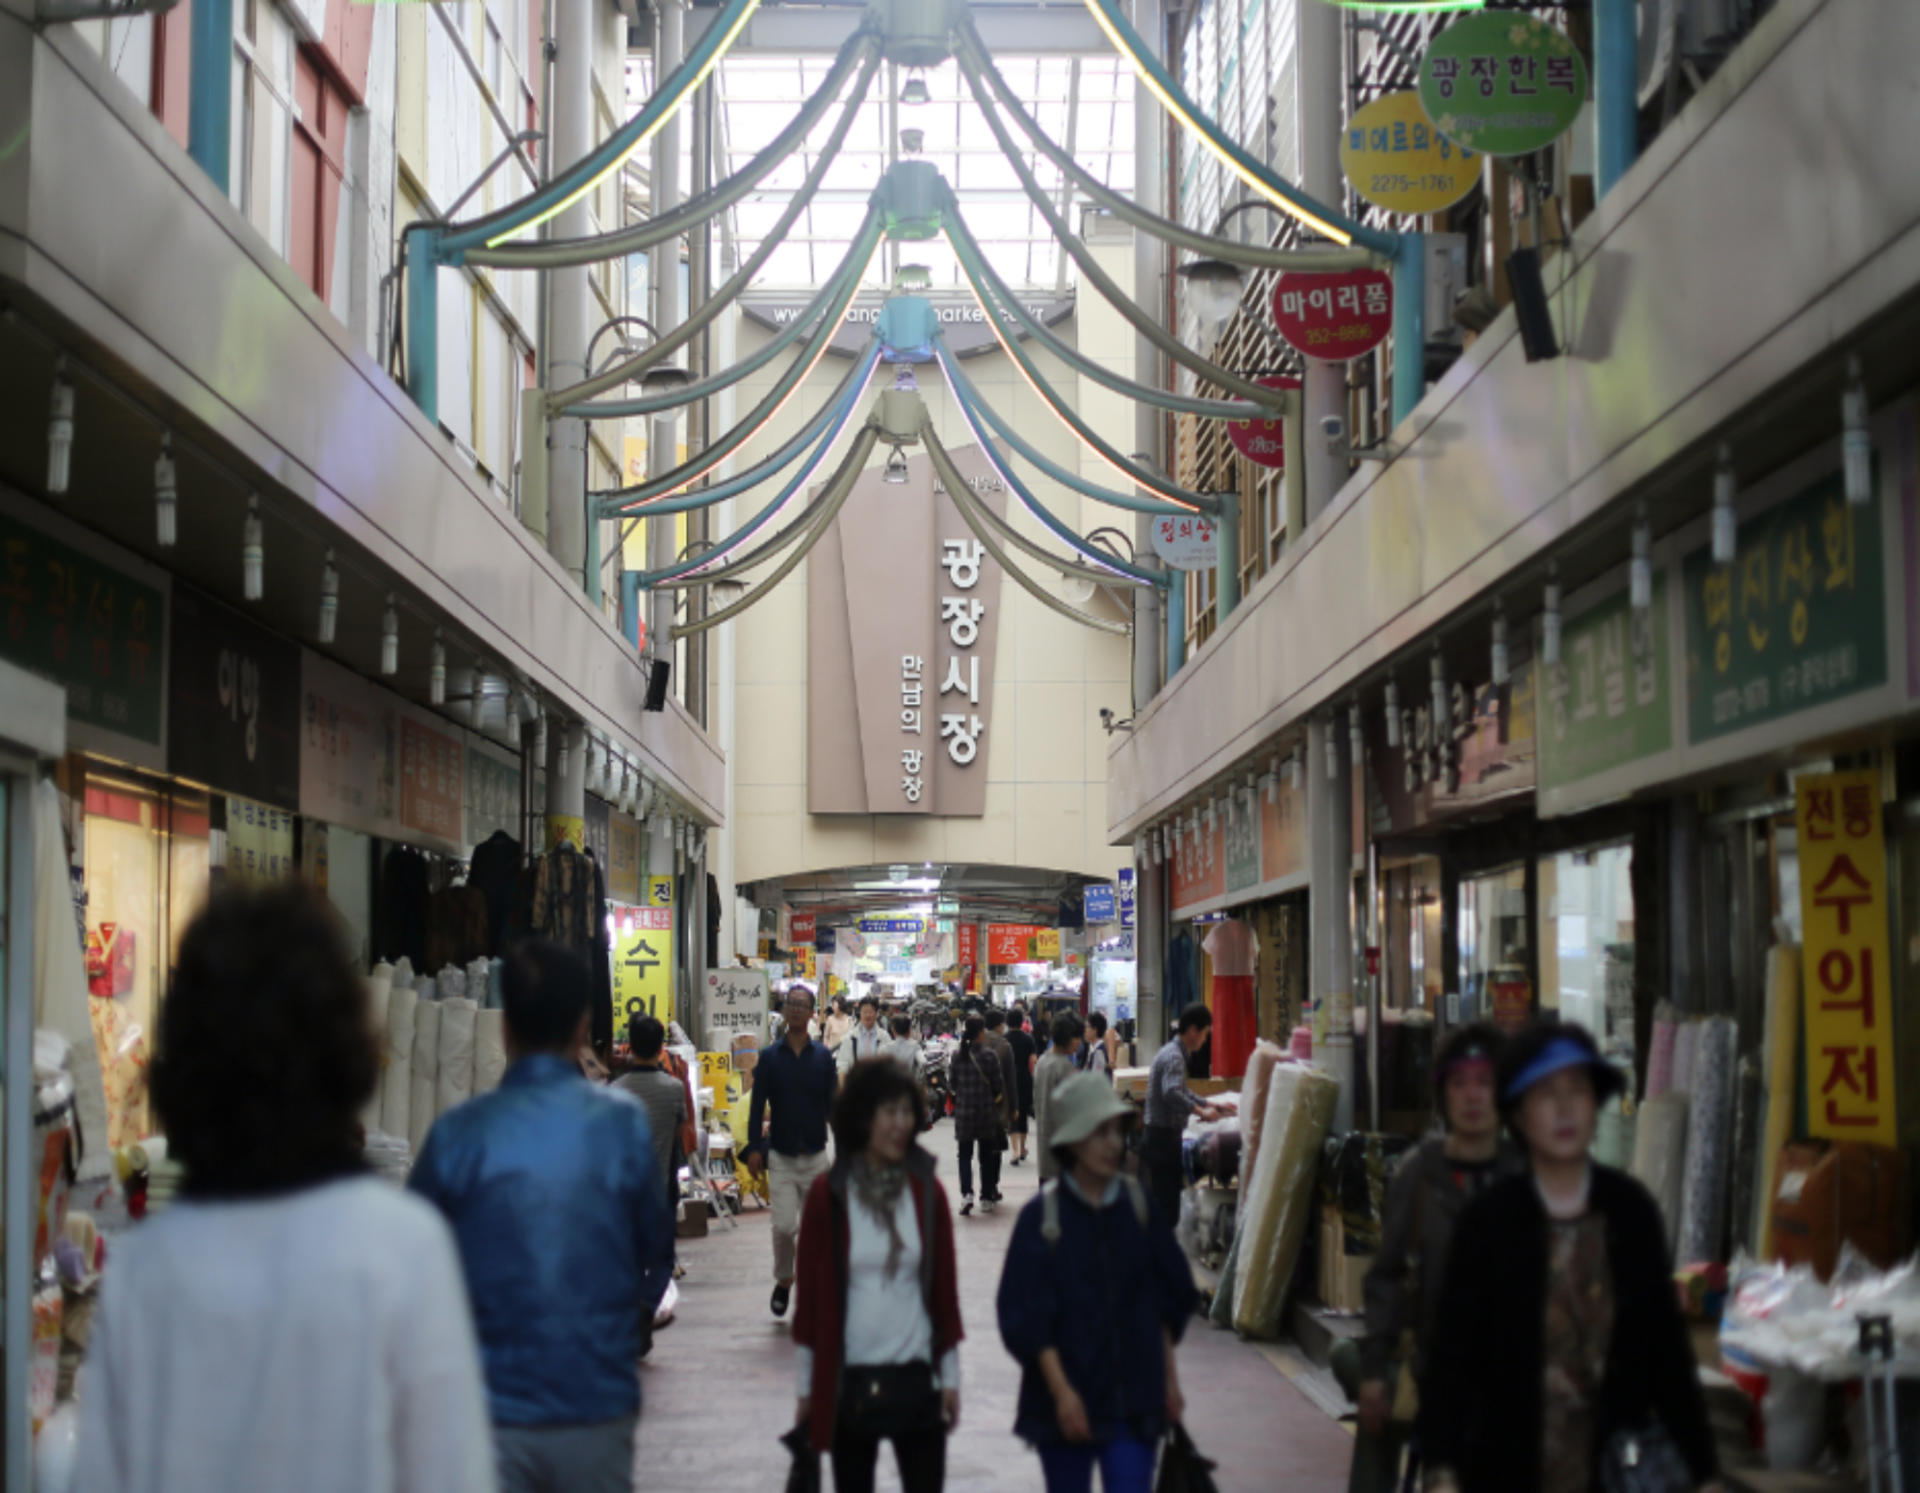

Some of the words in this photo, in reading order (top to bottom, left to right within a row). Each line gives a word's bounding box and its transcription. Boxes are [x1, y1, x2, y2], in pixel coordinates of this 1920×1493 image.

[1431, 54, 1576, 99] 광장한복
[1371, 174, 1455, 194] 2275-1761
[1281, 282, 1389, 323] 마이리폼
[940, 538, 985, 766] 광장시장
[901, 655, 924, 735] 만남의
[901, 749, 923, 802] 광장
[1804, 785, 1874, 842] 전통
